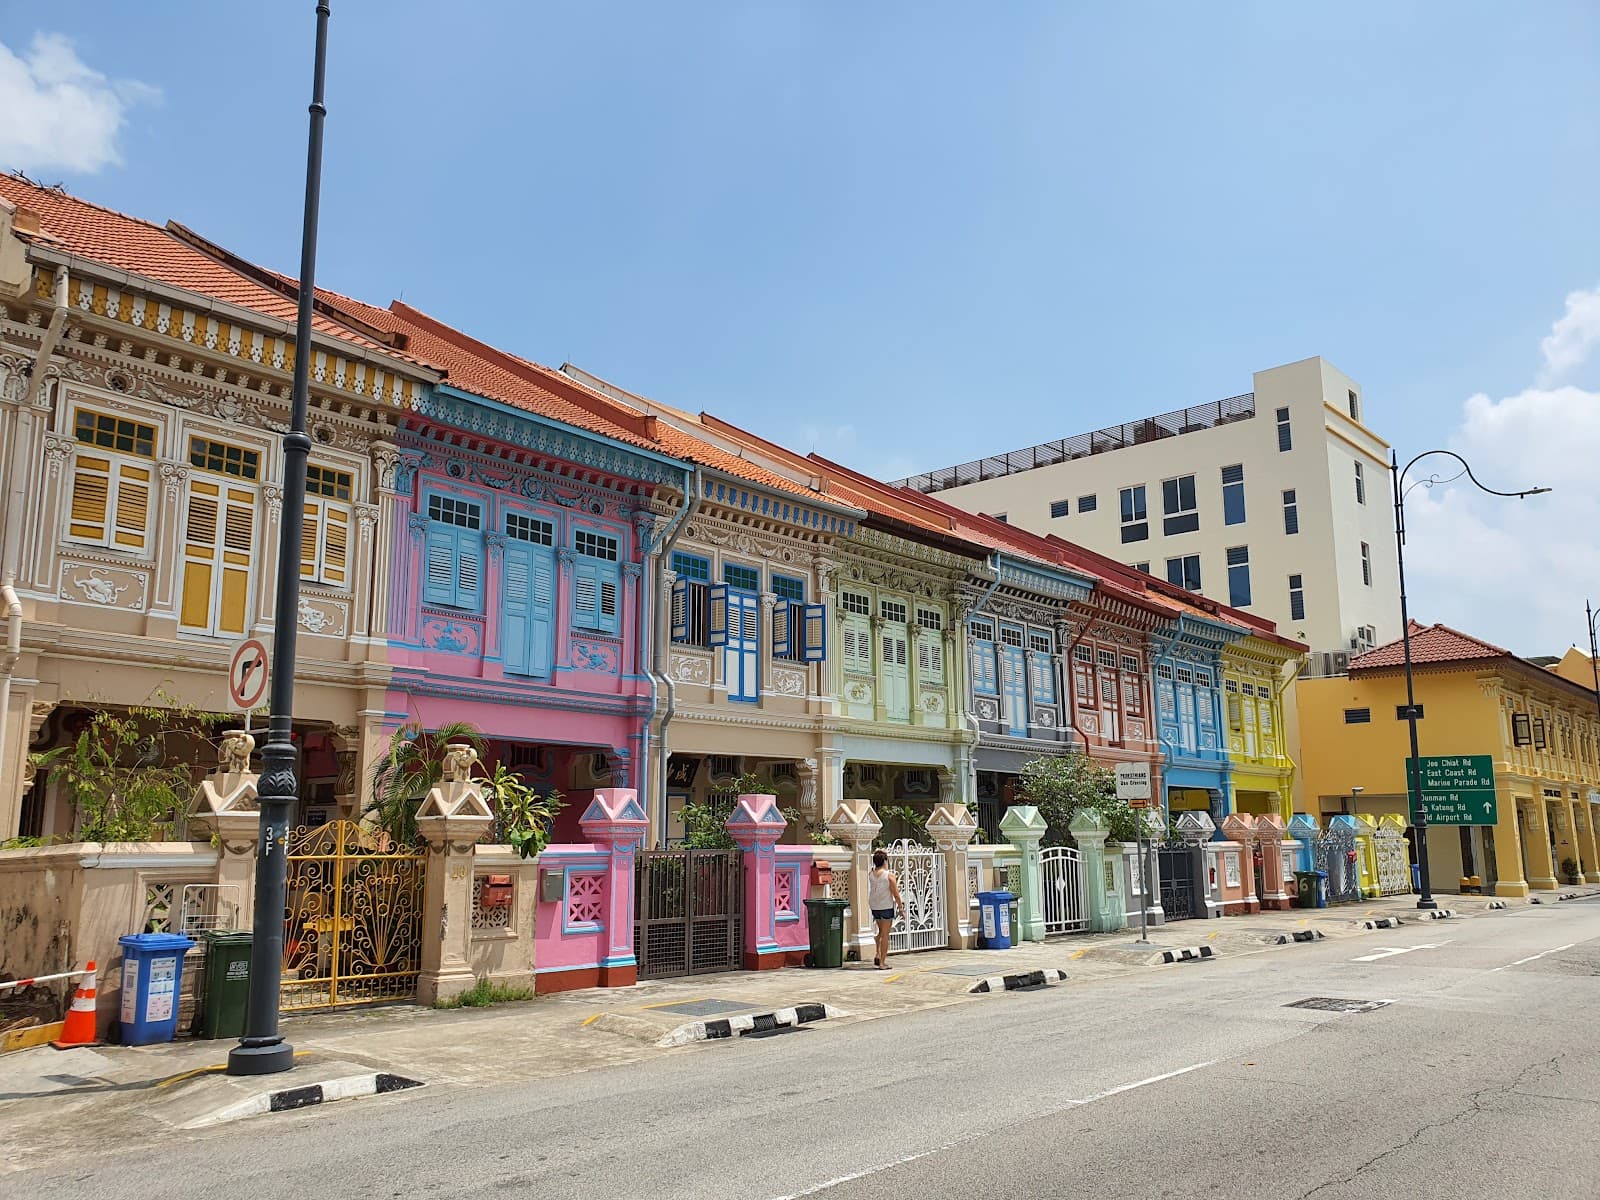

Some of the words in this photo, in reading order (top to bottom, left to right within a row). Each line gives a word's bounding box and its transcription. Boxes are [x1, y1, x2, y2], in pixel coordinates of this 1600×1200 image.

[1441, 759, 1459, 767] Chiat
[1427, 769, 1441, 777] East
[1445, 769, 1464, 777] Coast
[1428, 779, 1450, 787] Marine
[1454, 778, 1477, 786] Parade
[1450, 793, 1458, 801] Rd
[1431, 804, 1454, 812] Katong
[1457, 803, 1466, 811] Rd
[1436, 813, 1460, 822] Airport
[1463, 813, 1472, 821] Rd
